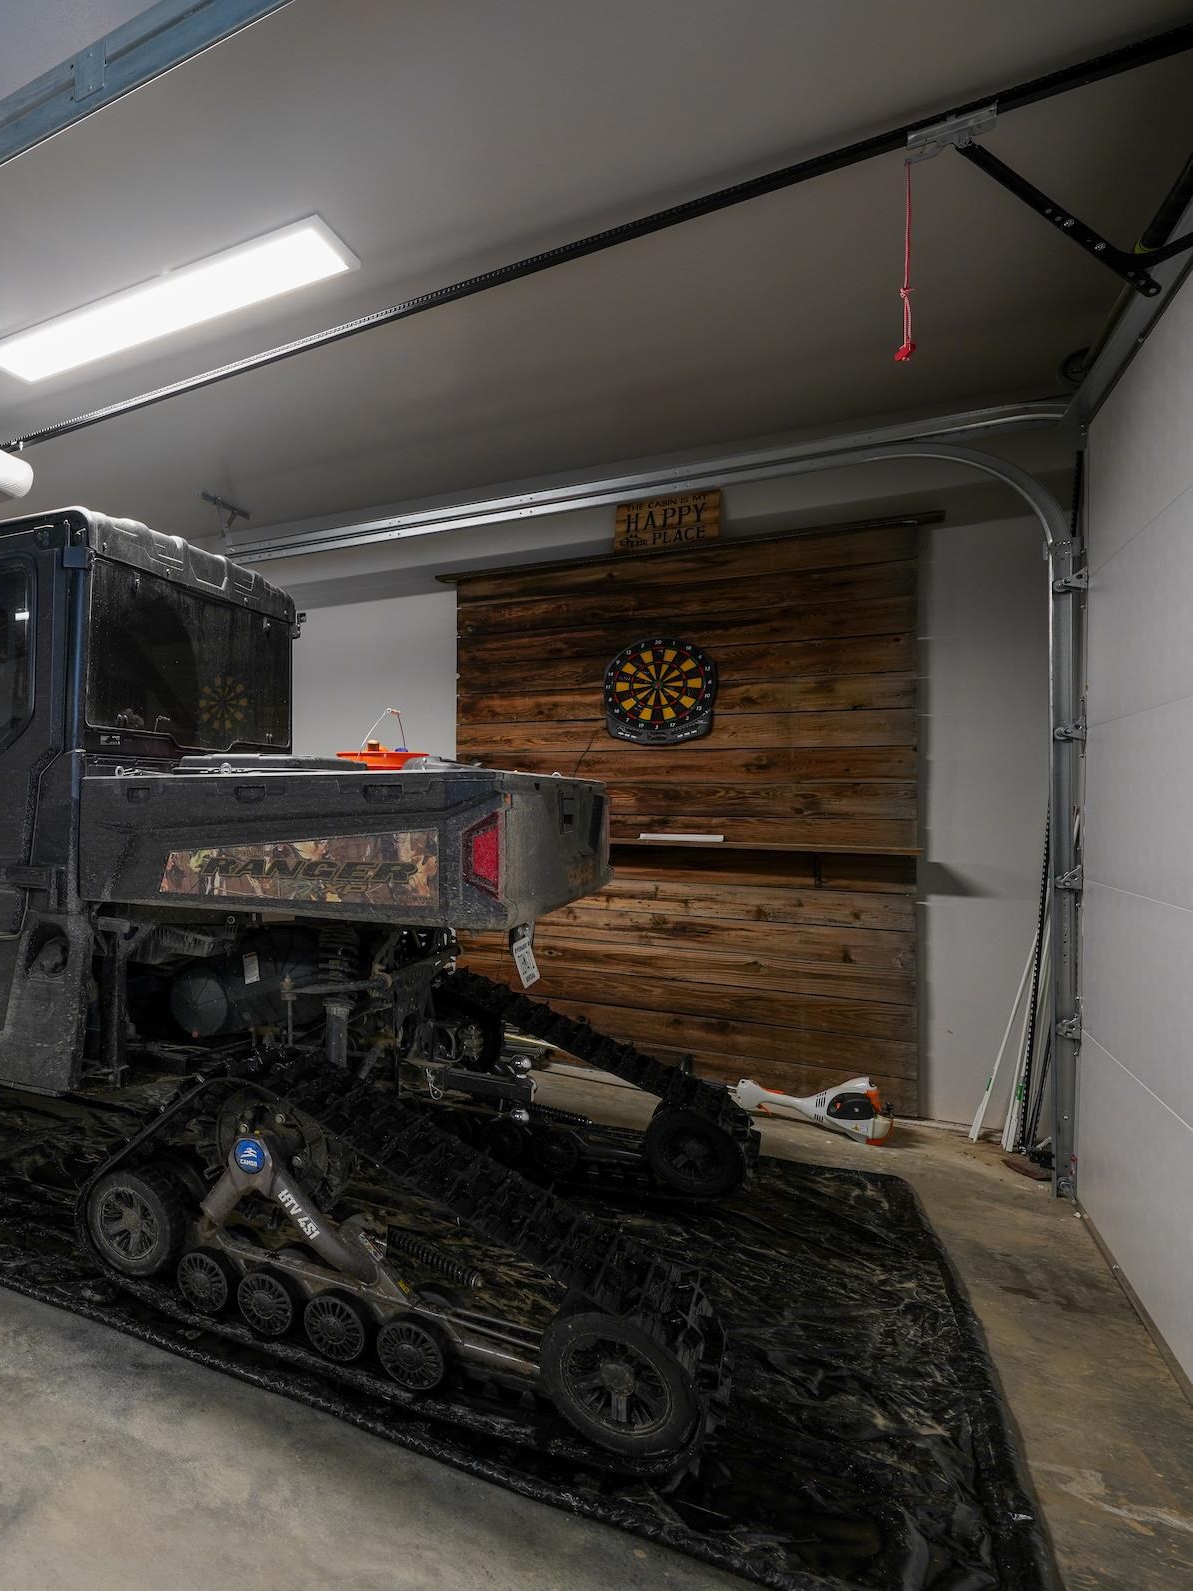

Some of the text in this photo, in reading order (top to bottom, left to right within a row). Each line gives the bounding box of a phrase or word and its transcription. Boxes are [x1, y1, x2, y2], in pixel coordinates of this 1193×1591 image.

[648, 498, 677, 509] CABIN
[680, 496, 689, 504] IS
[627, 503, 706, 533] HAPPY
[653, 525, 705, 545] PLACE
[200, 855, 418, 885] RANGER
[322, 882, 369, 896] XP
[278, 1188, 303, 1216] UTV
